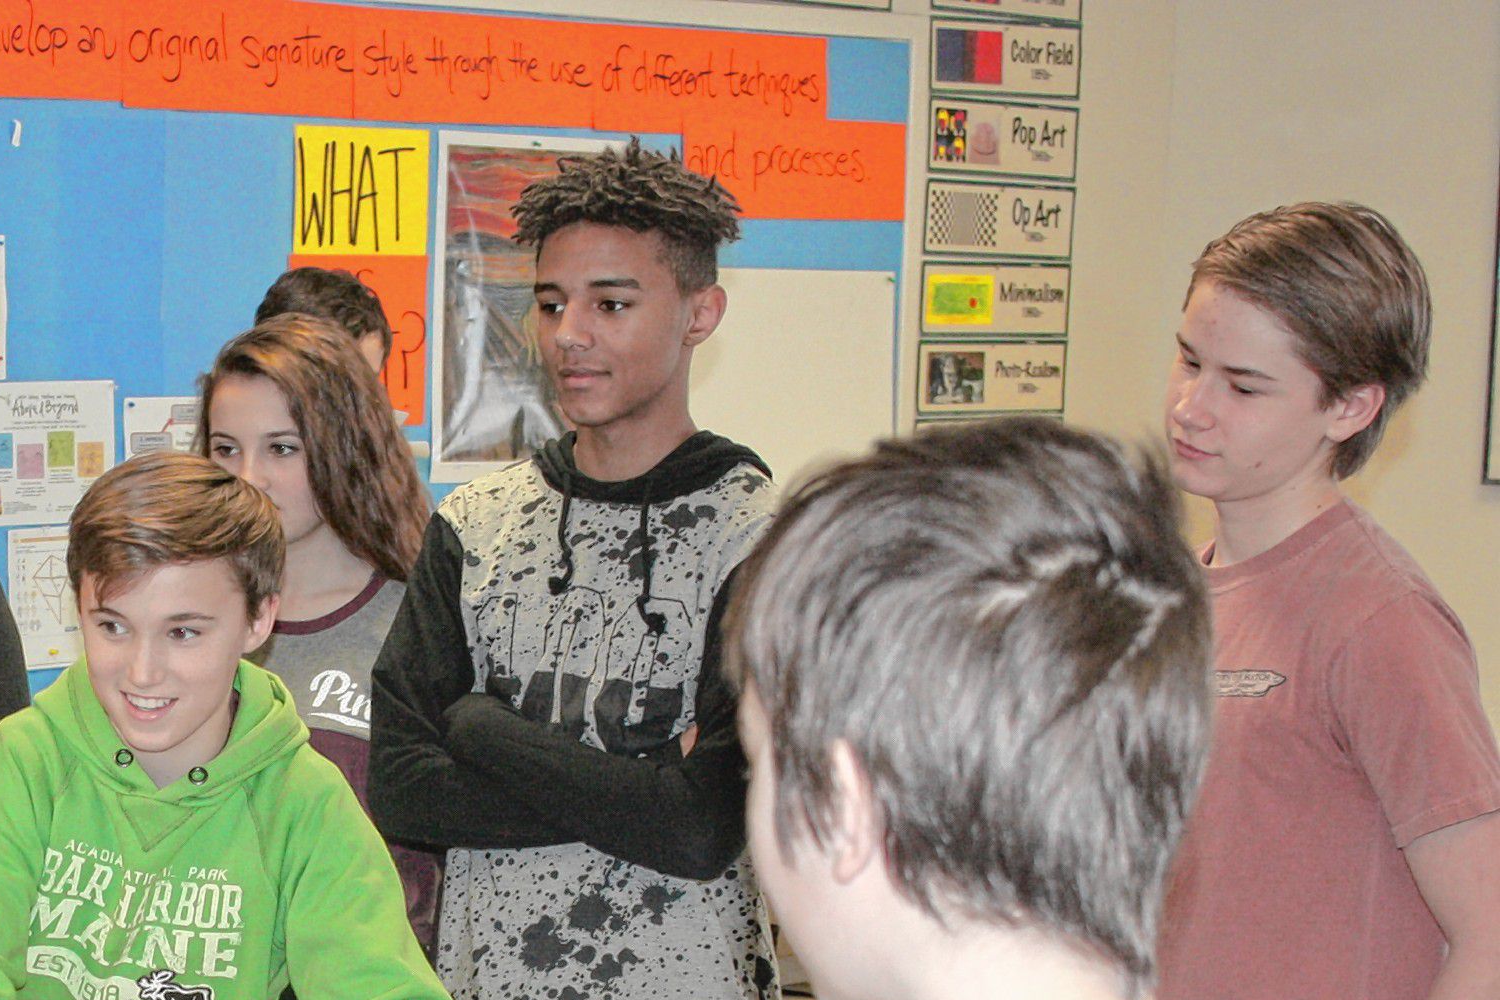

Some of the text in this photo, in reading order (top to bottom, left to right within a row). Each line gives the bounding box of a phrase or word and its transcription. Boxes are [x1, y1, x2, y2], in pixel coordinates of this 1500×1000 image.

[77, 25, 117, 60] an
[129, 12, 228, 83] original
[363, 30, 417, 97] style
[425, 35, 498, 99] through
[508, 39, 541, 82] the
[551, 58, 593, 87] use
[602, 44, 631, 92] of
[1011, 38, 1074, 65] Color Field
[1012, 116, 1067, 150] Pop Art
[688, 130, 740, 179] and
[298, 136, 416, 252] WHAT
[1012, 197, 1061, 232] Op Art
[64, 839, 124, 868] ACADIA
[187, 866, 228, 881] PARK
[40, 847, 113, 907] BAR
[28, 891, 242, 979] MAINE
